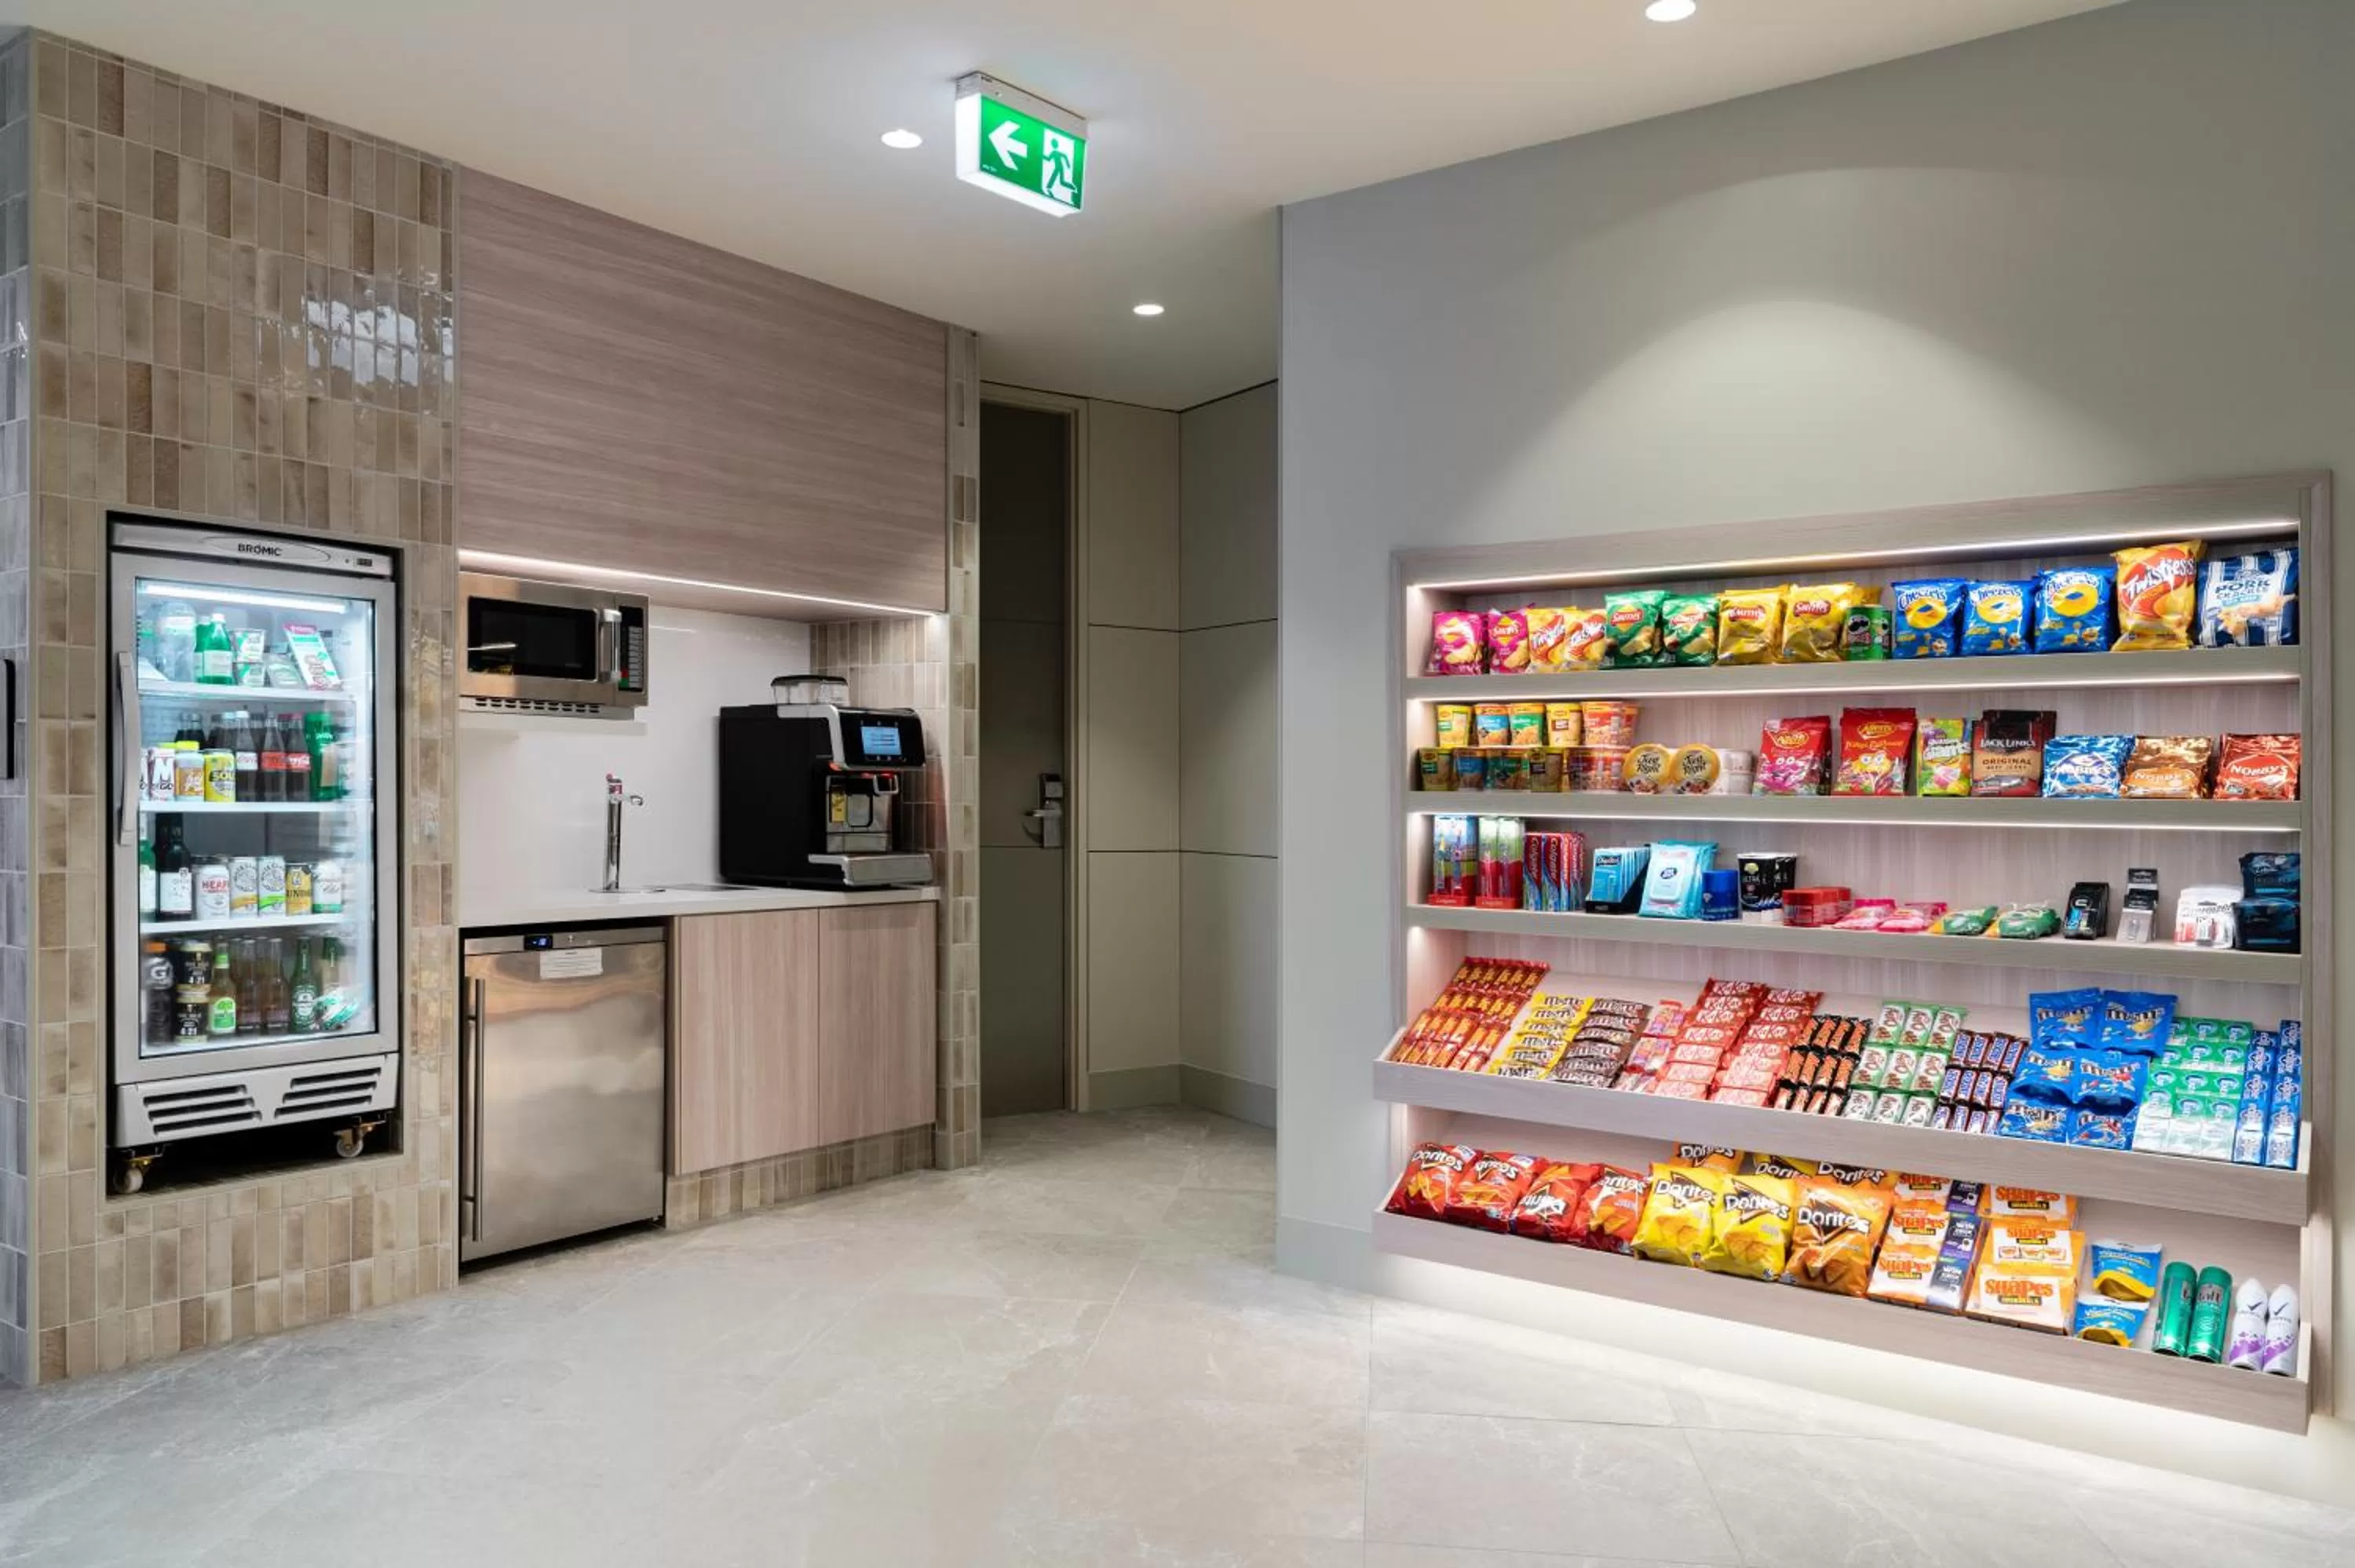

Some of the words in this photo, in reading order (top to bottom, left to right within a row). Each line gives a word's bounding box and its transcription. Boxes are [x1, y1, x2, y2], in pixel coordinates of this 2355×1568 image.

[238, 543, 283, 556] BROMIC
[2128, 556, 2196, 600] Twisties
[2215, 580, 2270, 594] PORK
[1817, 1161, 1885, 1183] Doritos
[1725, 1194, 1791, 1220] Doritos
[1798, 1206, 1871, 1234] Doritos
[1985, 1278, 2054, 1297] Shapes
